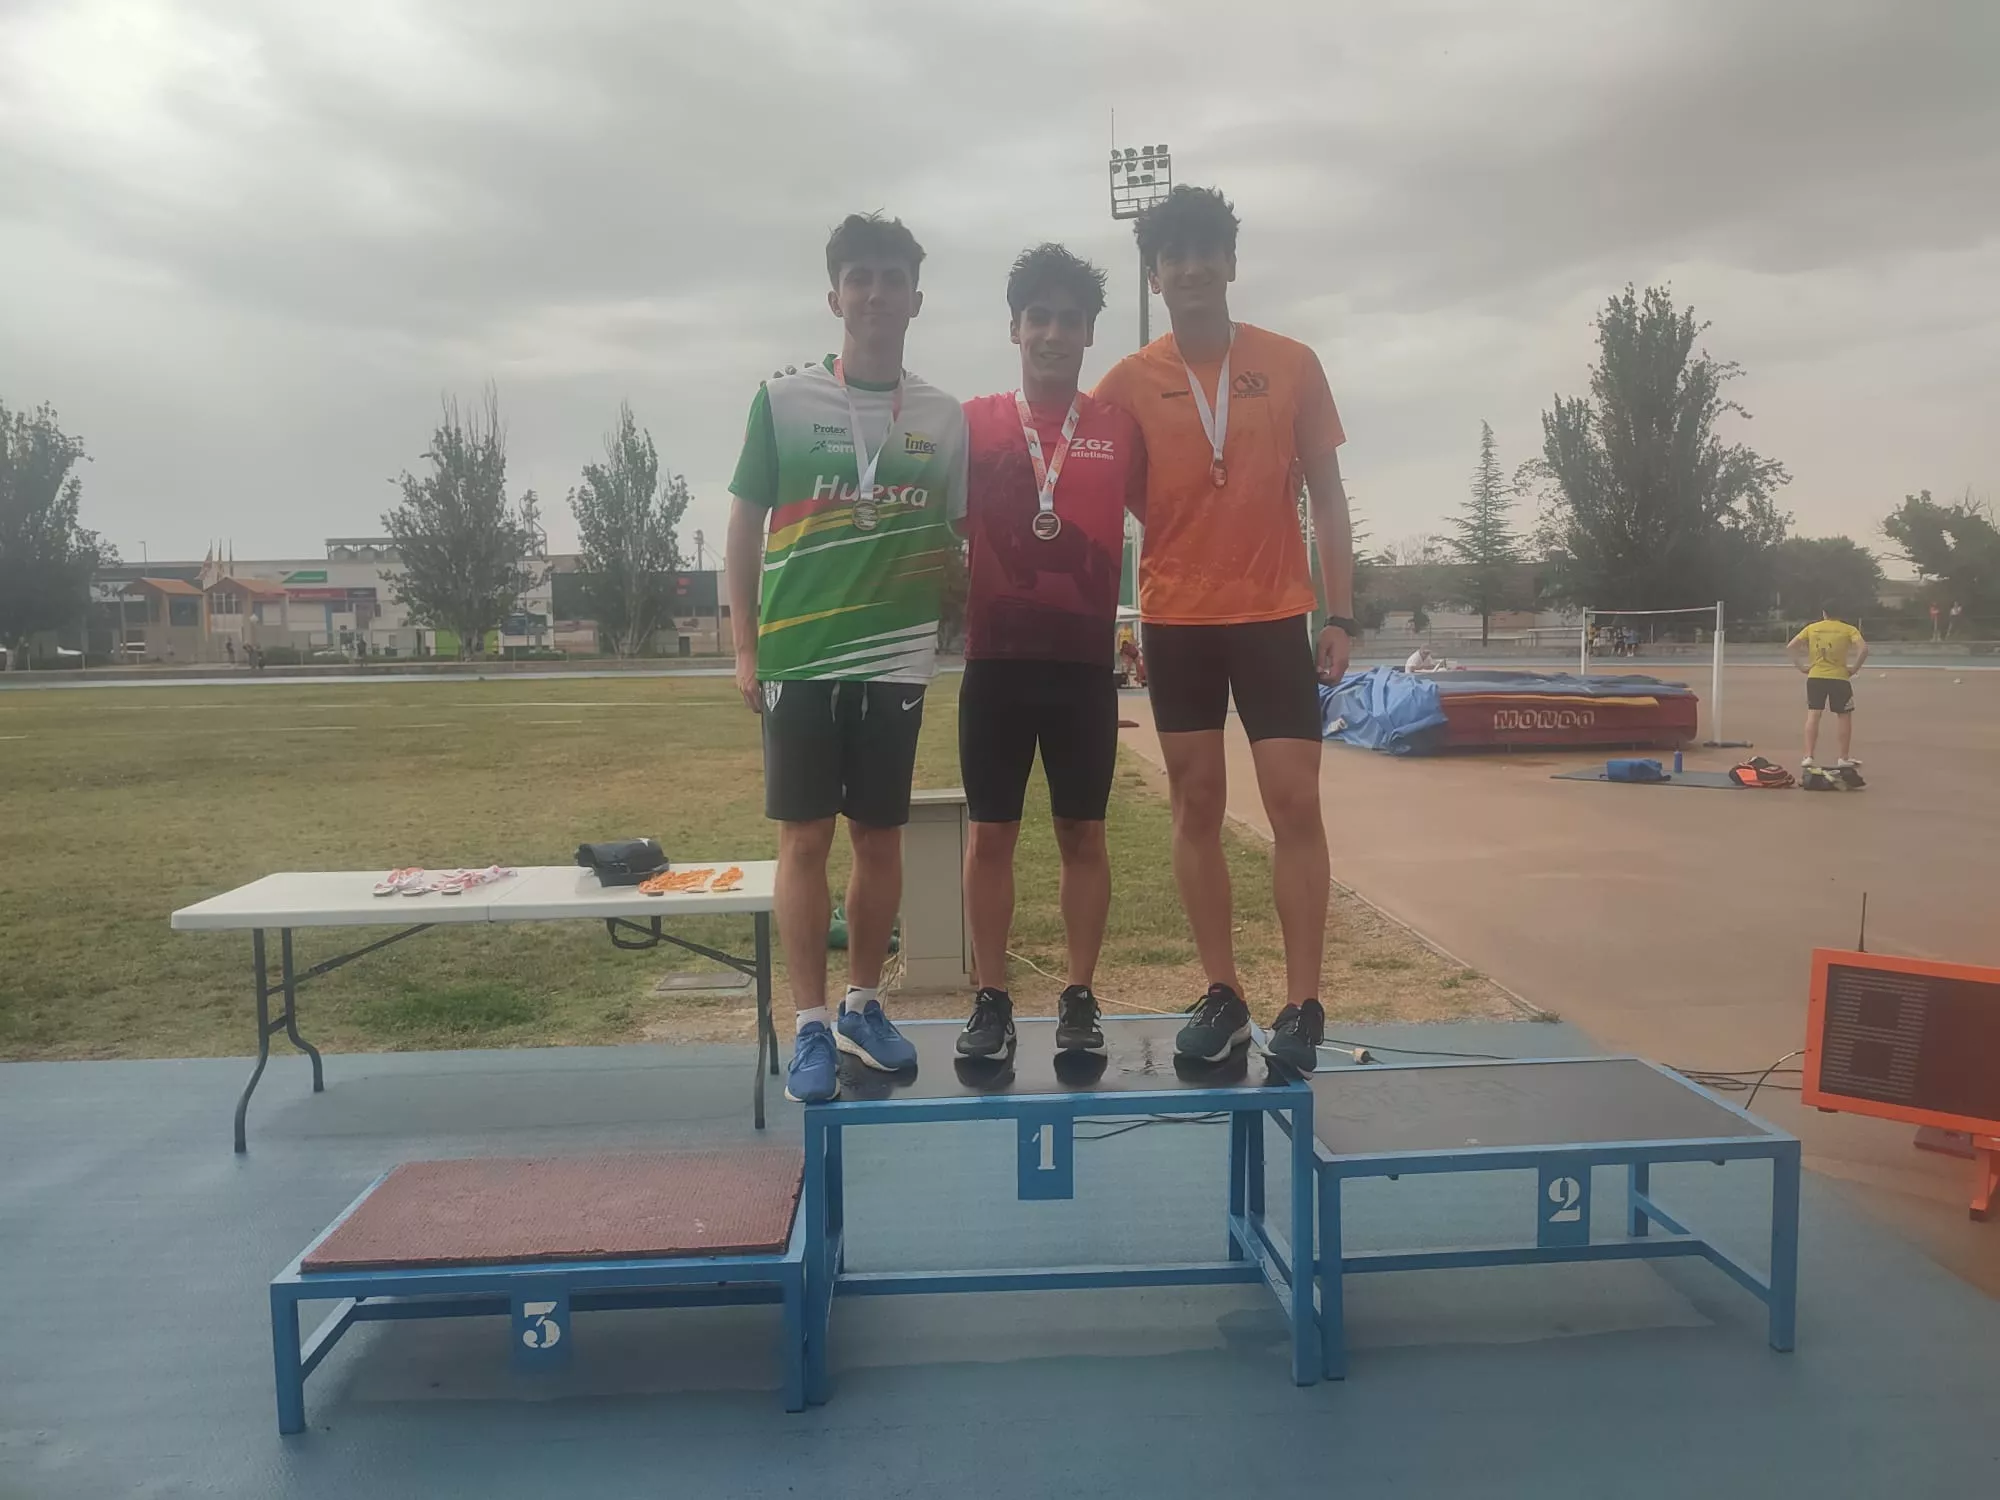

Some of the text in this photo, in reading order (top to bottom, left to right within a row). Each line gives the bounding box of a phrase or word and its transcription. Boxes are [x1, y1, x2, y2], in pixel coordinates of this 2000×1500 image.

[1071, 438, 1114, 452] ZGZ
[1071, 451, 1114, 460] atletismo
[812, 474, 929, 507] Huesca
[1493, 709, 1595, 730] MONDO
[1032, 1124, 1056, 1170] 1
[1548, 1177, 1581, 1222] 2
[523, 1301, 561, 1348] 3
